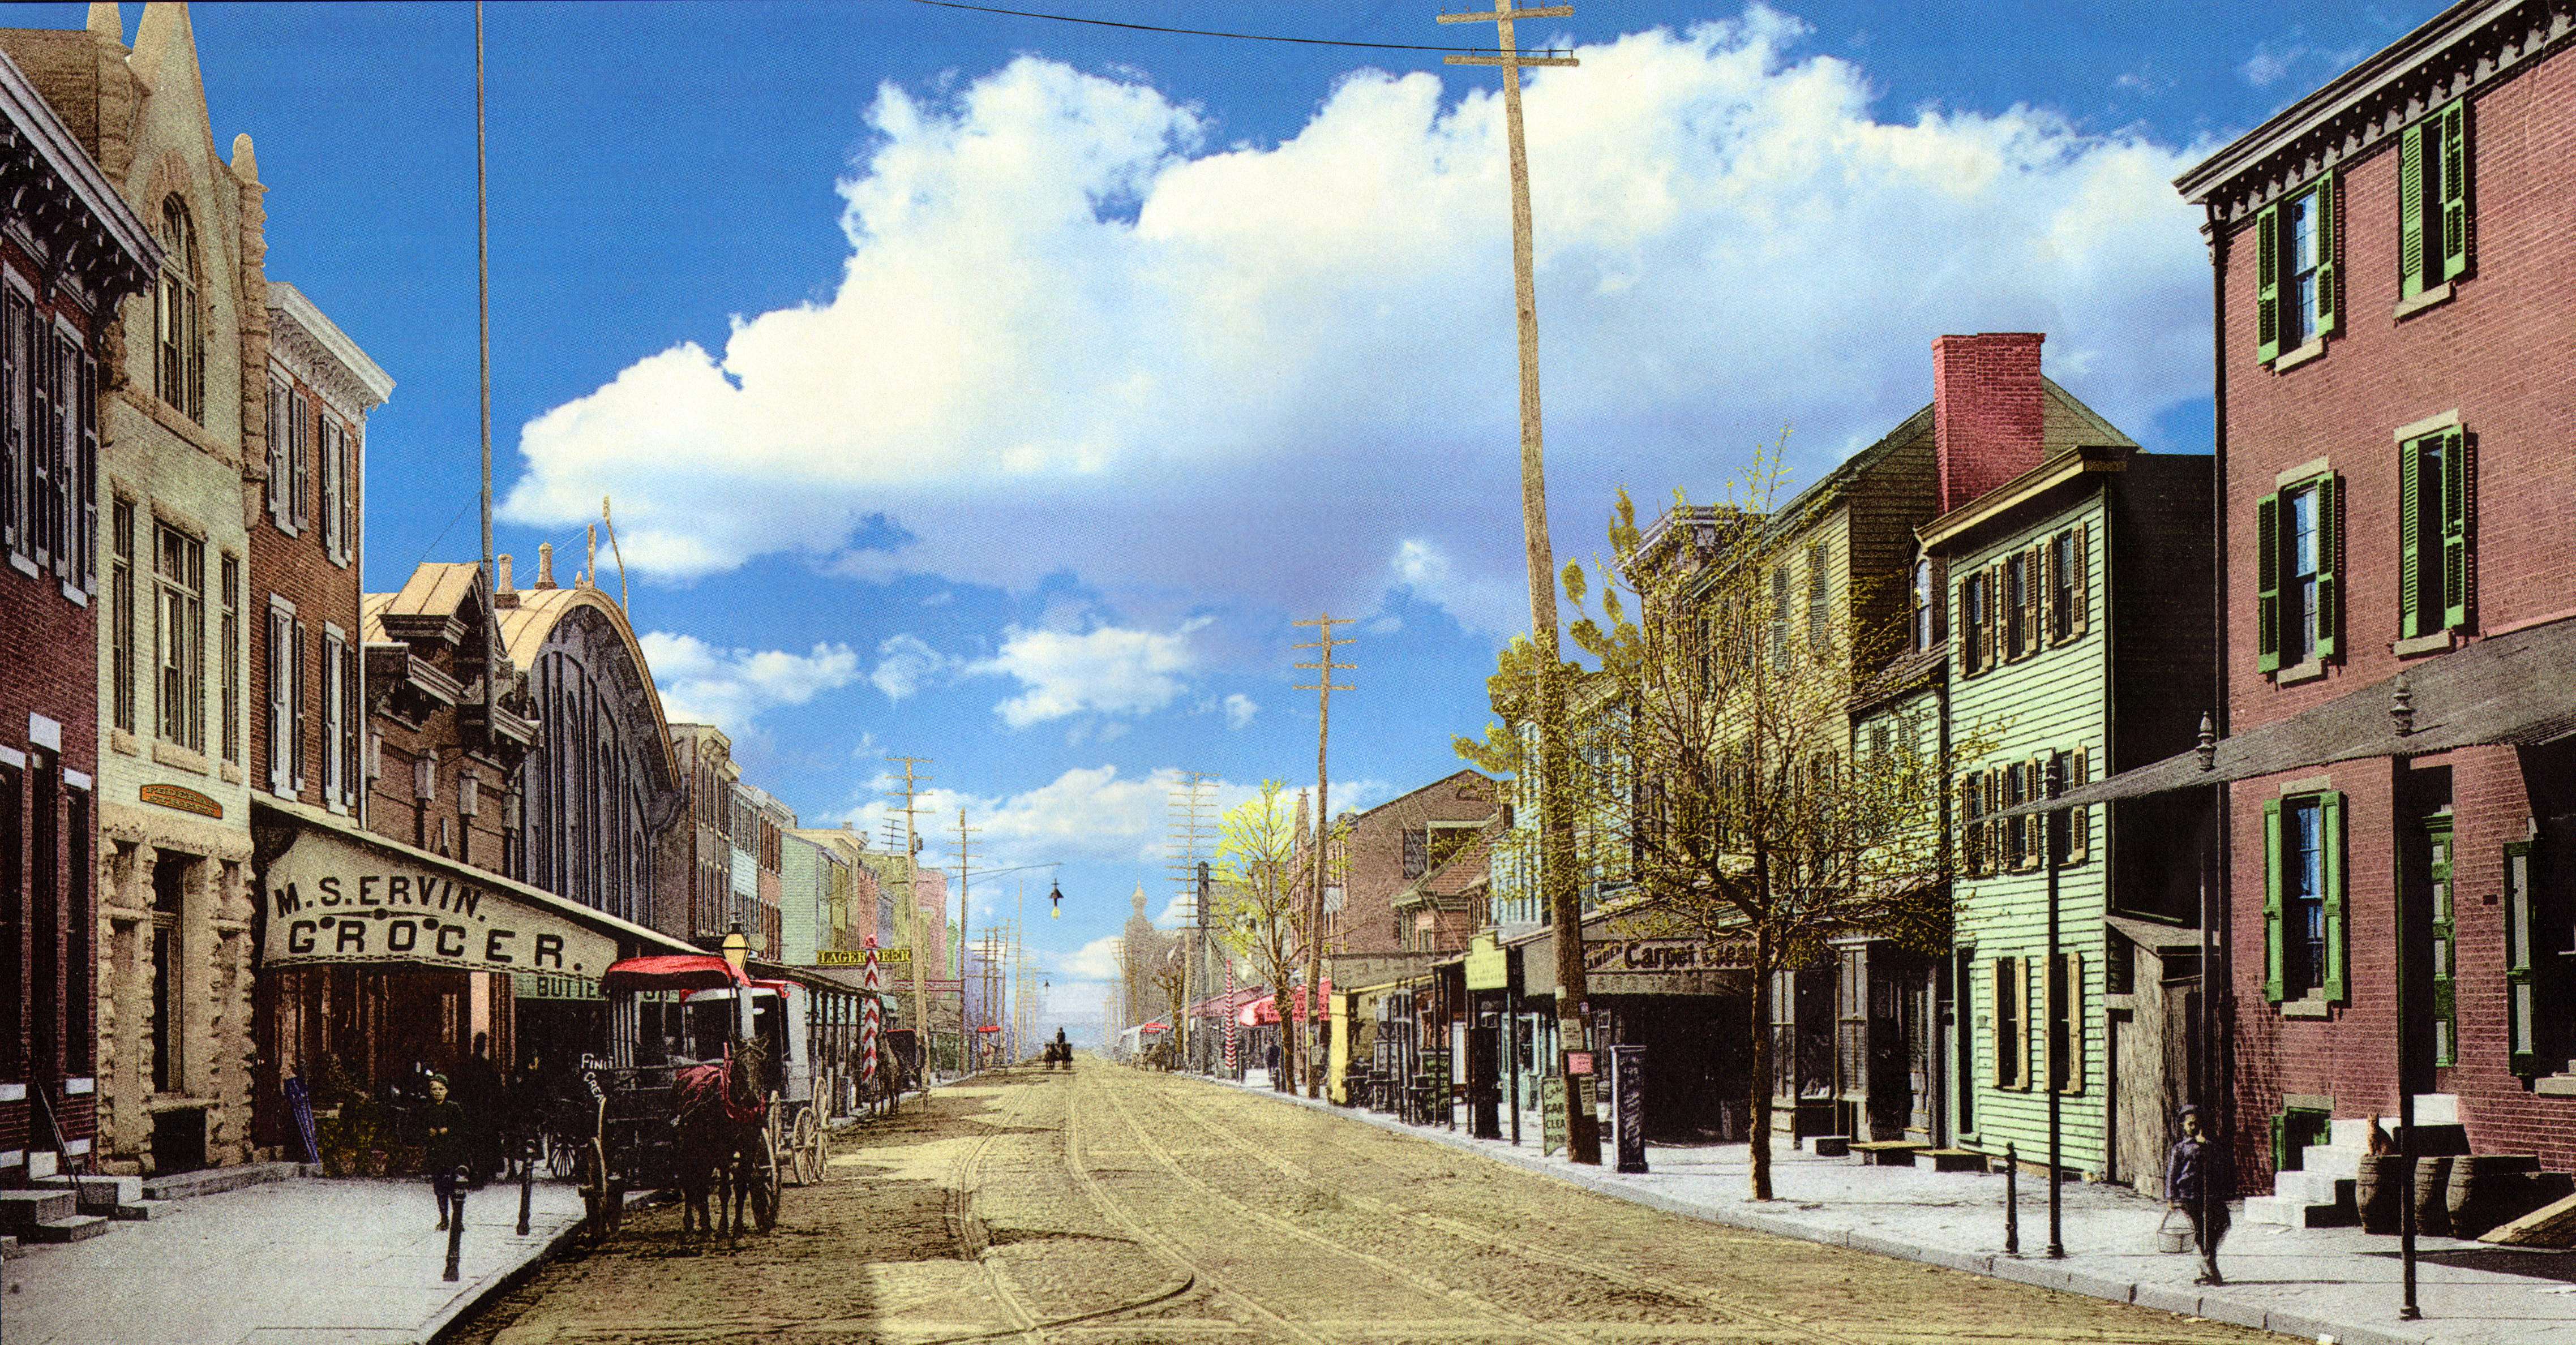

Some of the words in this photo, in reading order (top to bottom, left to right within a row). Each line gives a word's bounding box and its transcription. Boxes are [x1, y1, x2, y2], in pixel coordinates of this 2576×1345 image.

[146, 787, 218, 810] FEDERAL
[149, 795, 215, 816] STREET
[820, 951, 866, 963] LAGER
[1584, 946, 1623, 969] AMDEN
[1624, 941, 1697, 971] Carpet
[537, 976, 601, 998] BUTTE
[1546, 1119, 1566, 1130] CLEA
